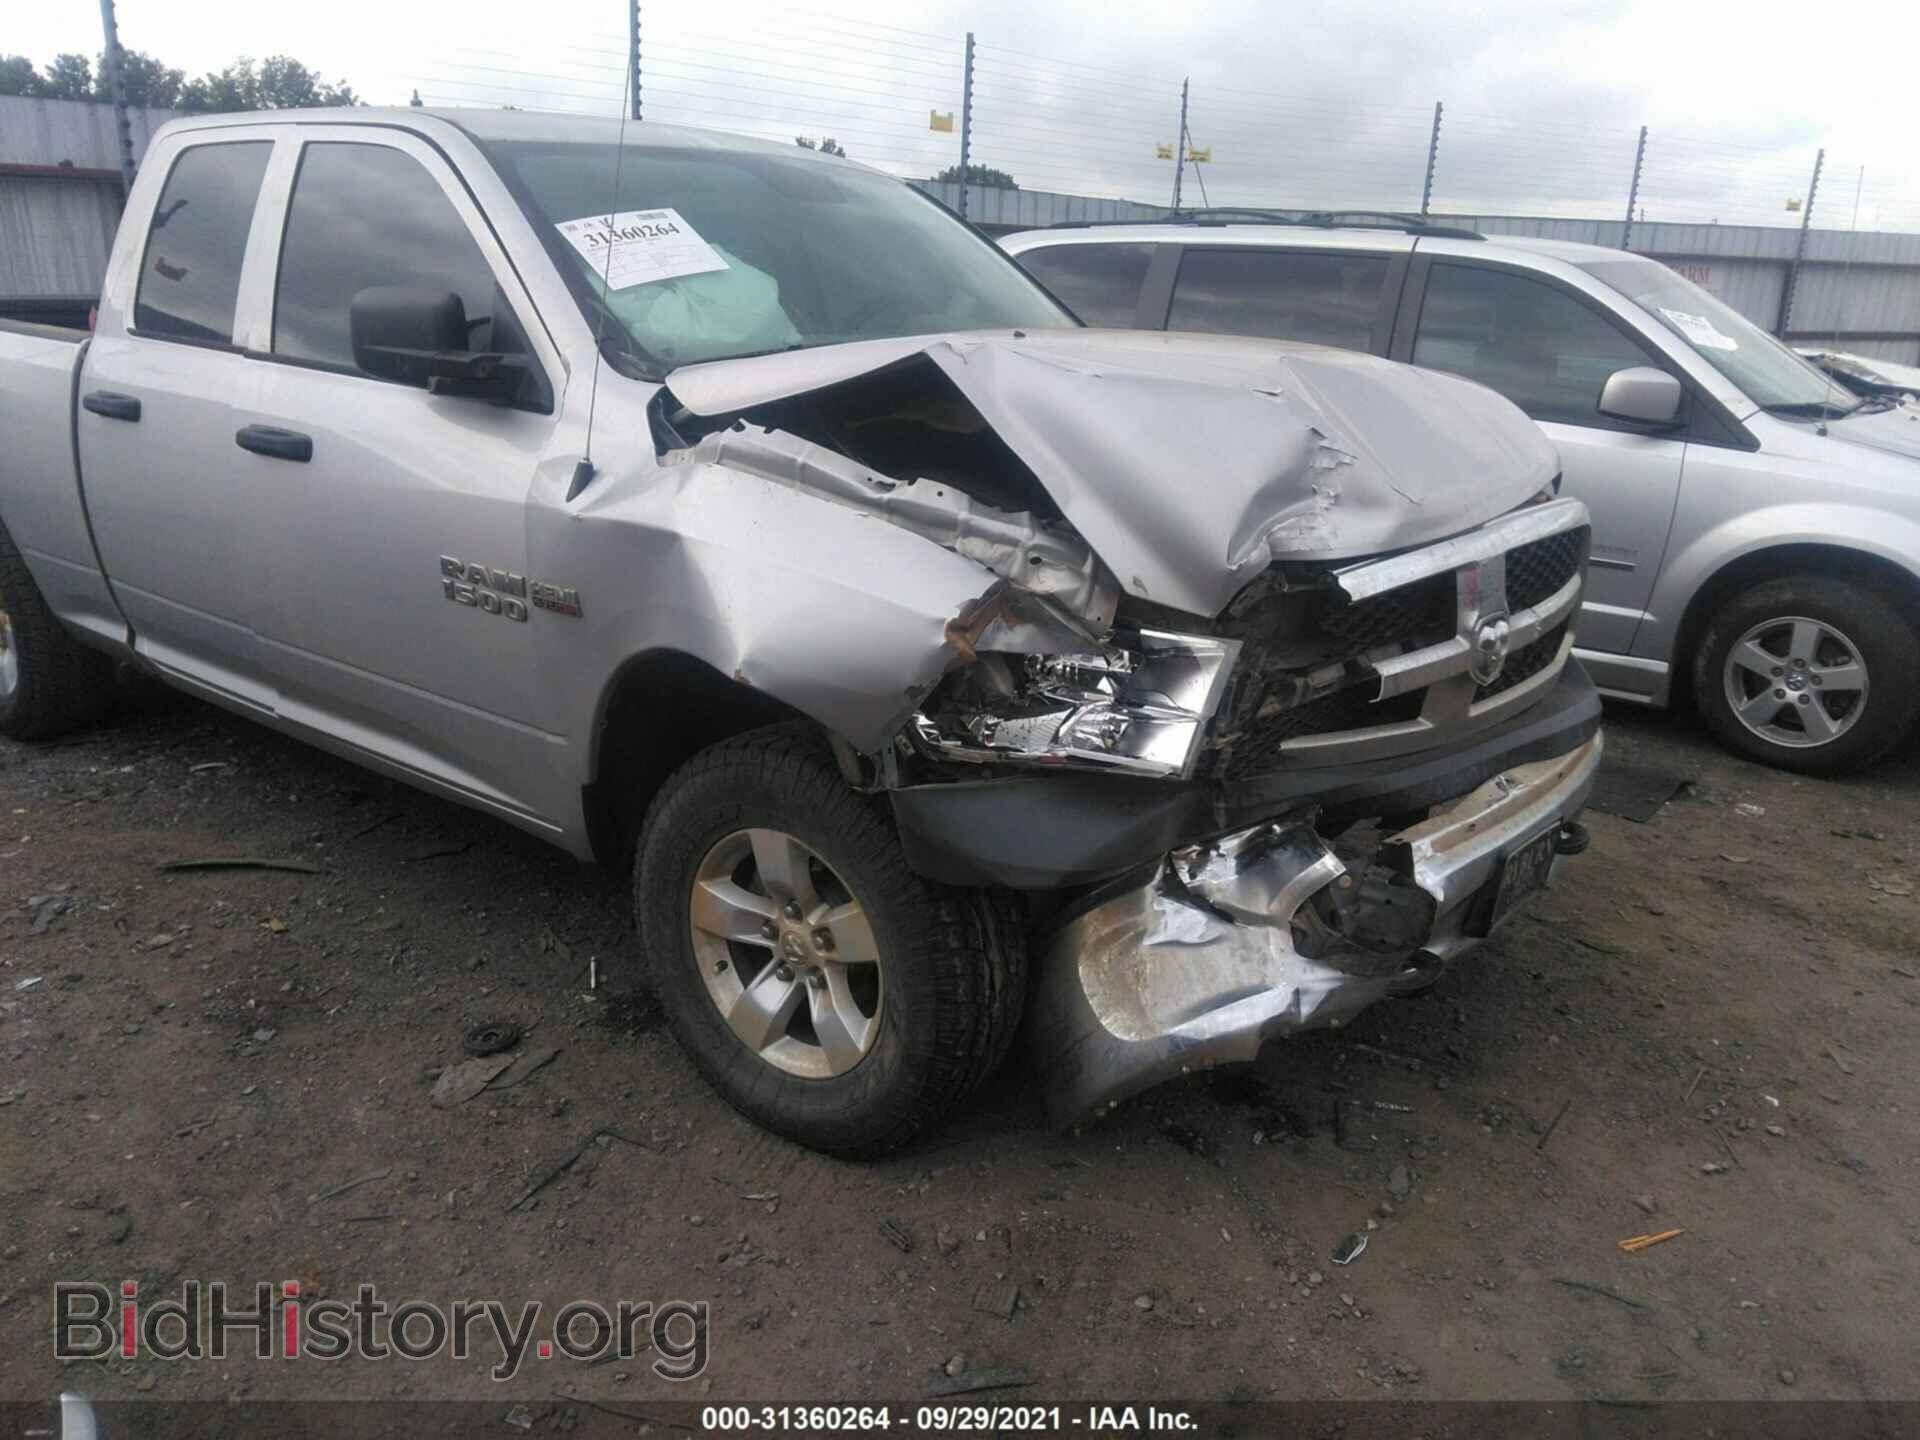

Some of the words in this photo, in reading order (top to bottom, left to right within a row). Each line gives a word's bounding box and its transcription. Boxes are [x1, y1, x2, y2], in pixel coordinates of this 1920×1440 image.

[583, 222, 681, 247] 31360264
[440, 554, 527, 598] RAM
[442, 578, 528, 623] 1500
